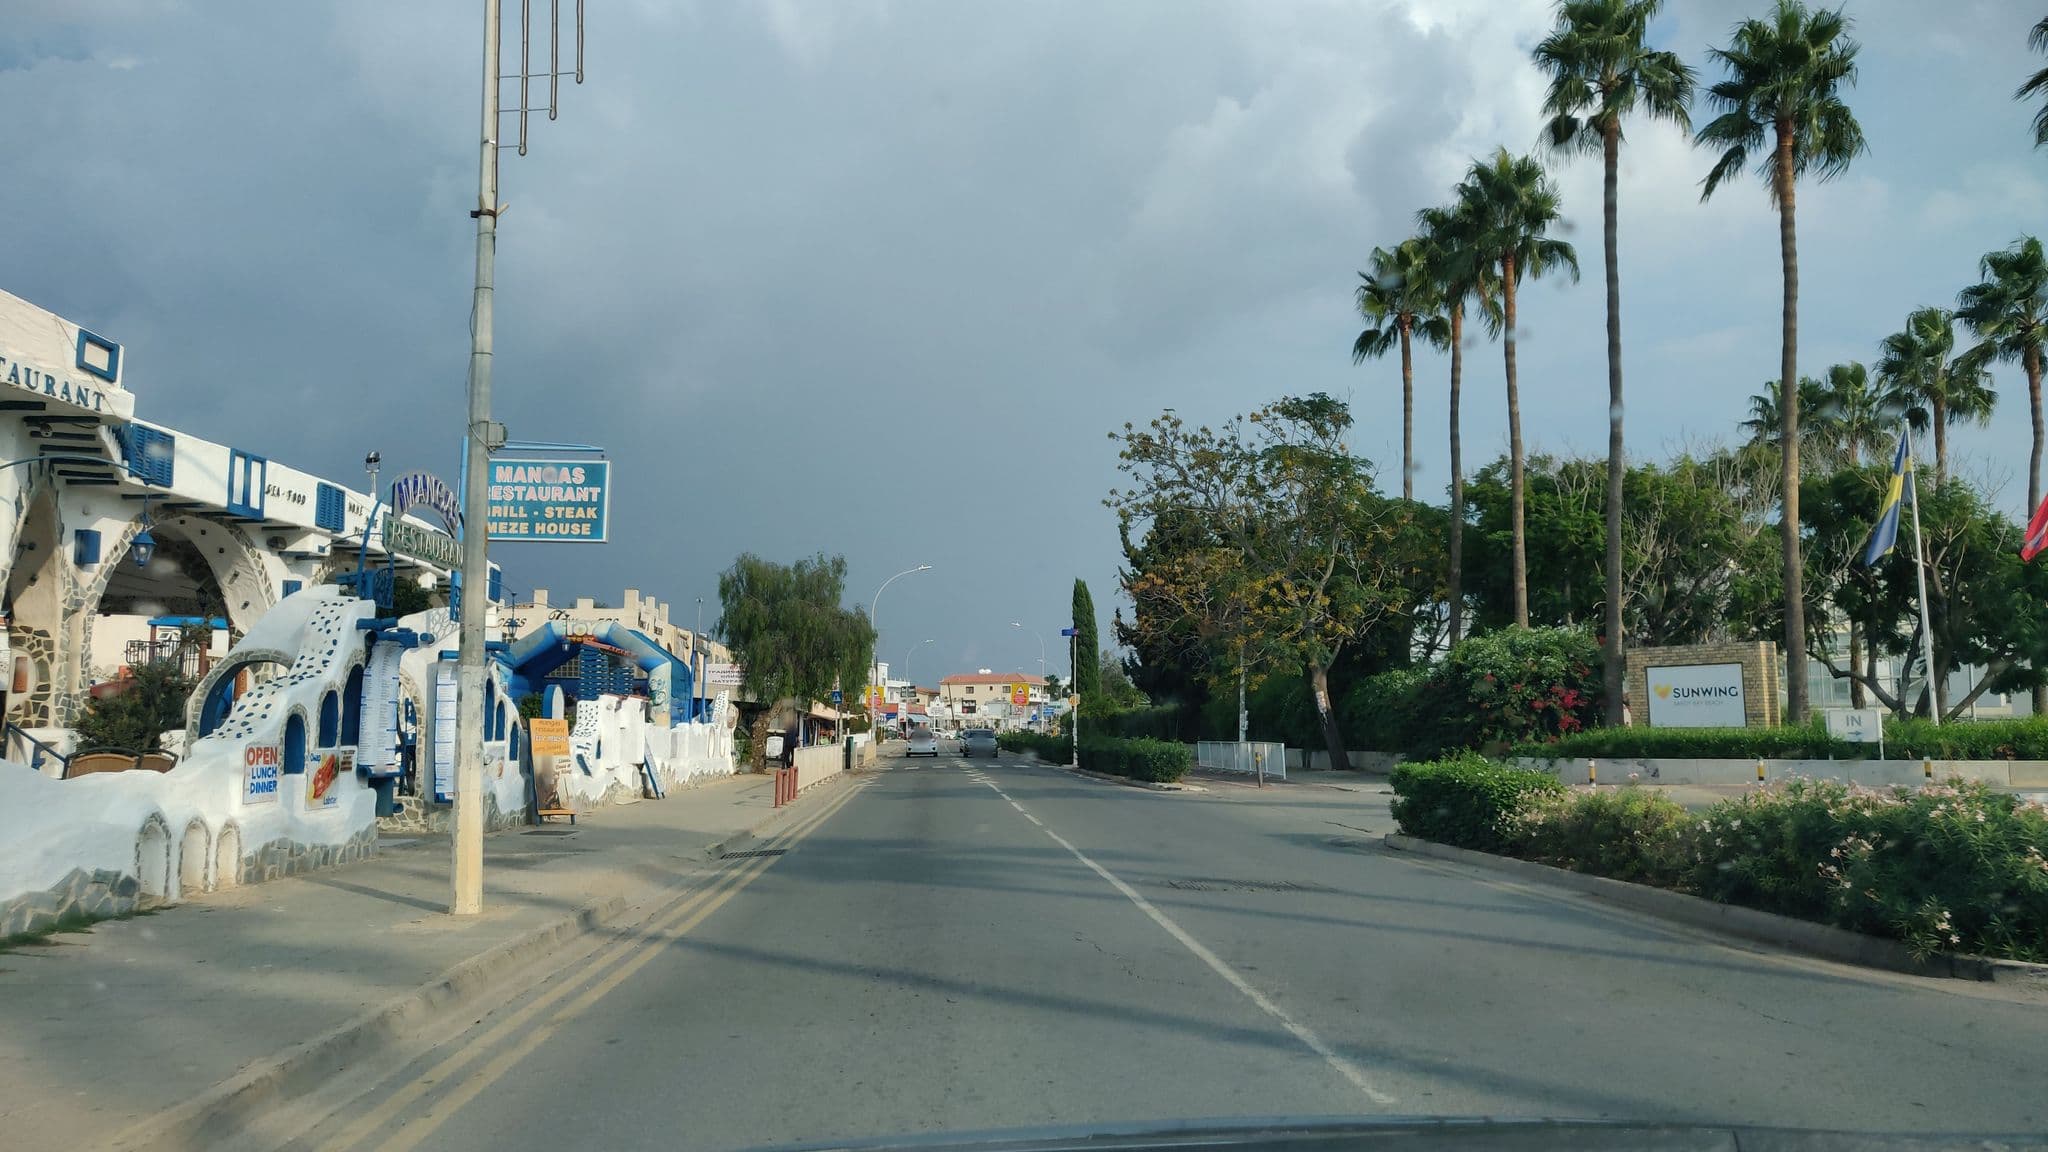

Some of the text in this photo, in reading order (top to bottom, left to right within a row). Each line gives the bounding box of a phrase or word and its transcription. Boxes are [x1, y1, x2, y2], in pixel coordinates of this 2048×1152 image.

[488, 486, 601, 502] ESTAURANT
[488, 506, 598, 519] RILL STEAK
[488, 522, 592, 535] MEZE HOUSE
[391, 520, 464, 567] RESTAURAN
[1673, 686, 1739, 699] SUNWING
[1846, 715, 1862, 727] IN
[246, 747, 278, 766] OPEN
[251, 767, 278, 779] LUNCH
[249, 780, 278, 795] DINNER
